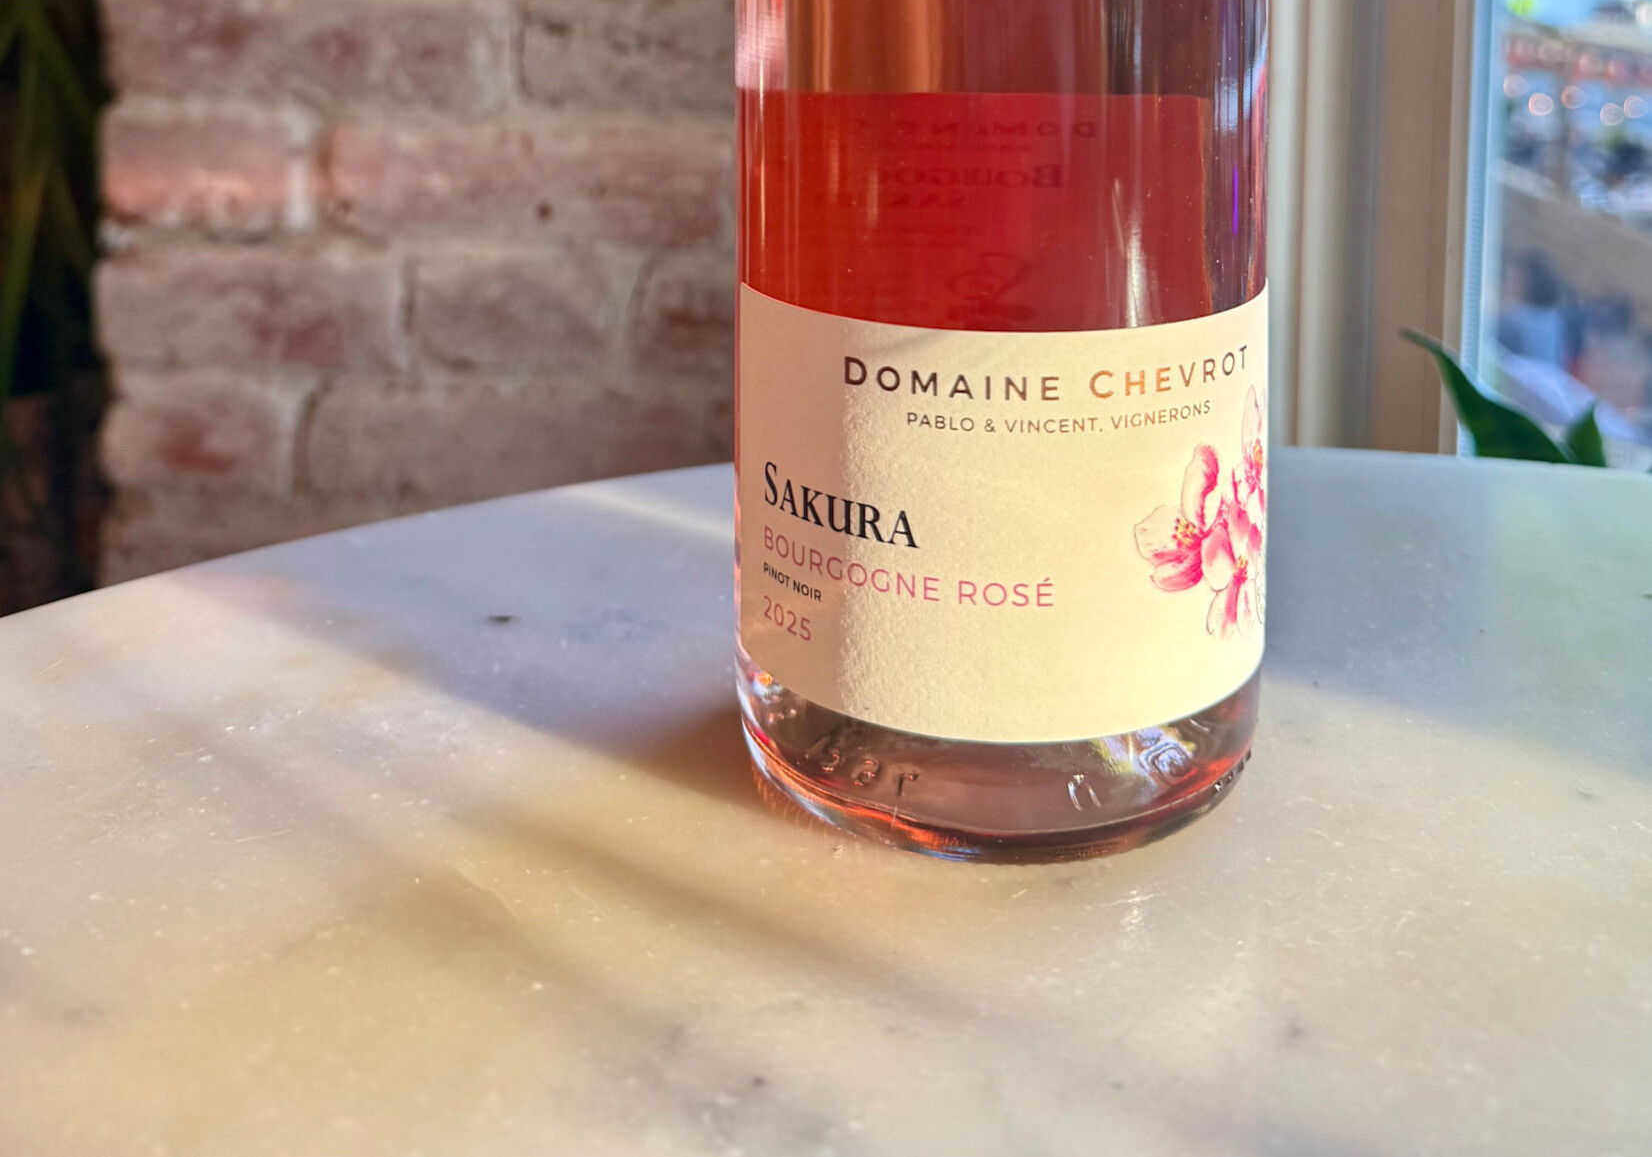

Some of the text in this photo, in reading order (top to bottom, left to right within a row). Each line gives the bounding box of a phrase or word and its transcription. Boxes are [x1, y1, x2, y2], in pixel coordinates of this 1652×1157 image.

[845, 344, 1247, 401] DOMAINE CHEVROT
[906, 411, 974, 433] PABLO
[984, 419, 997, 433] &
[1111, 400, 1211, 430] VIGNERONS
[764, 461, 920, 548] SAKURA
[763, 526, 1054, 608] BOURGOGNE ROSÉ
[763, 561, 822, 602] PINOT NOIR
[763, 594, 812, 642] 2025
